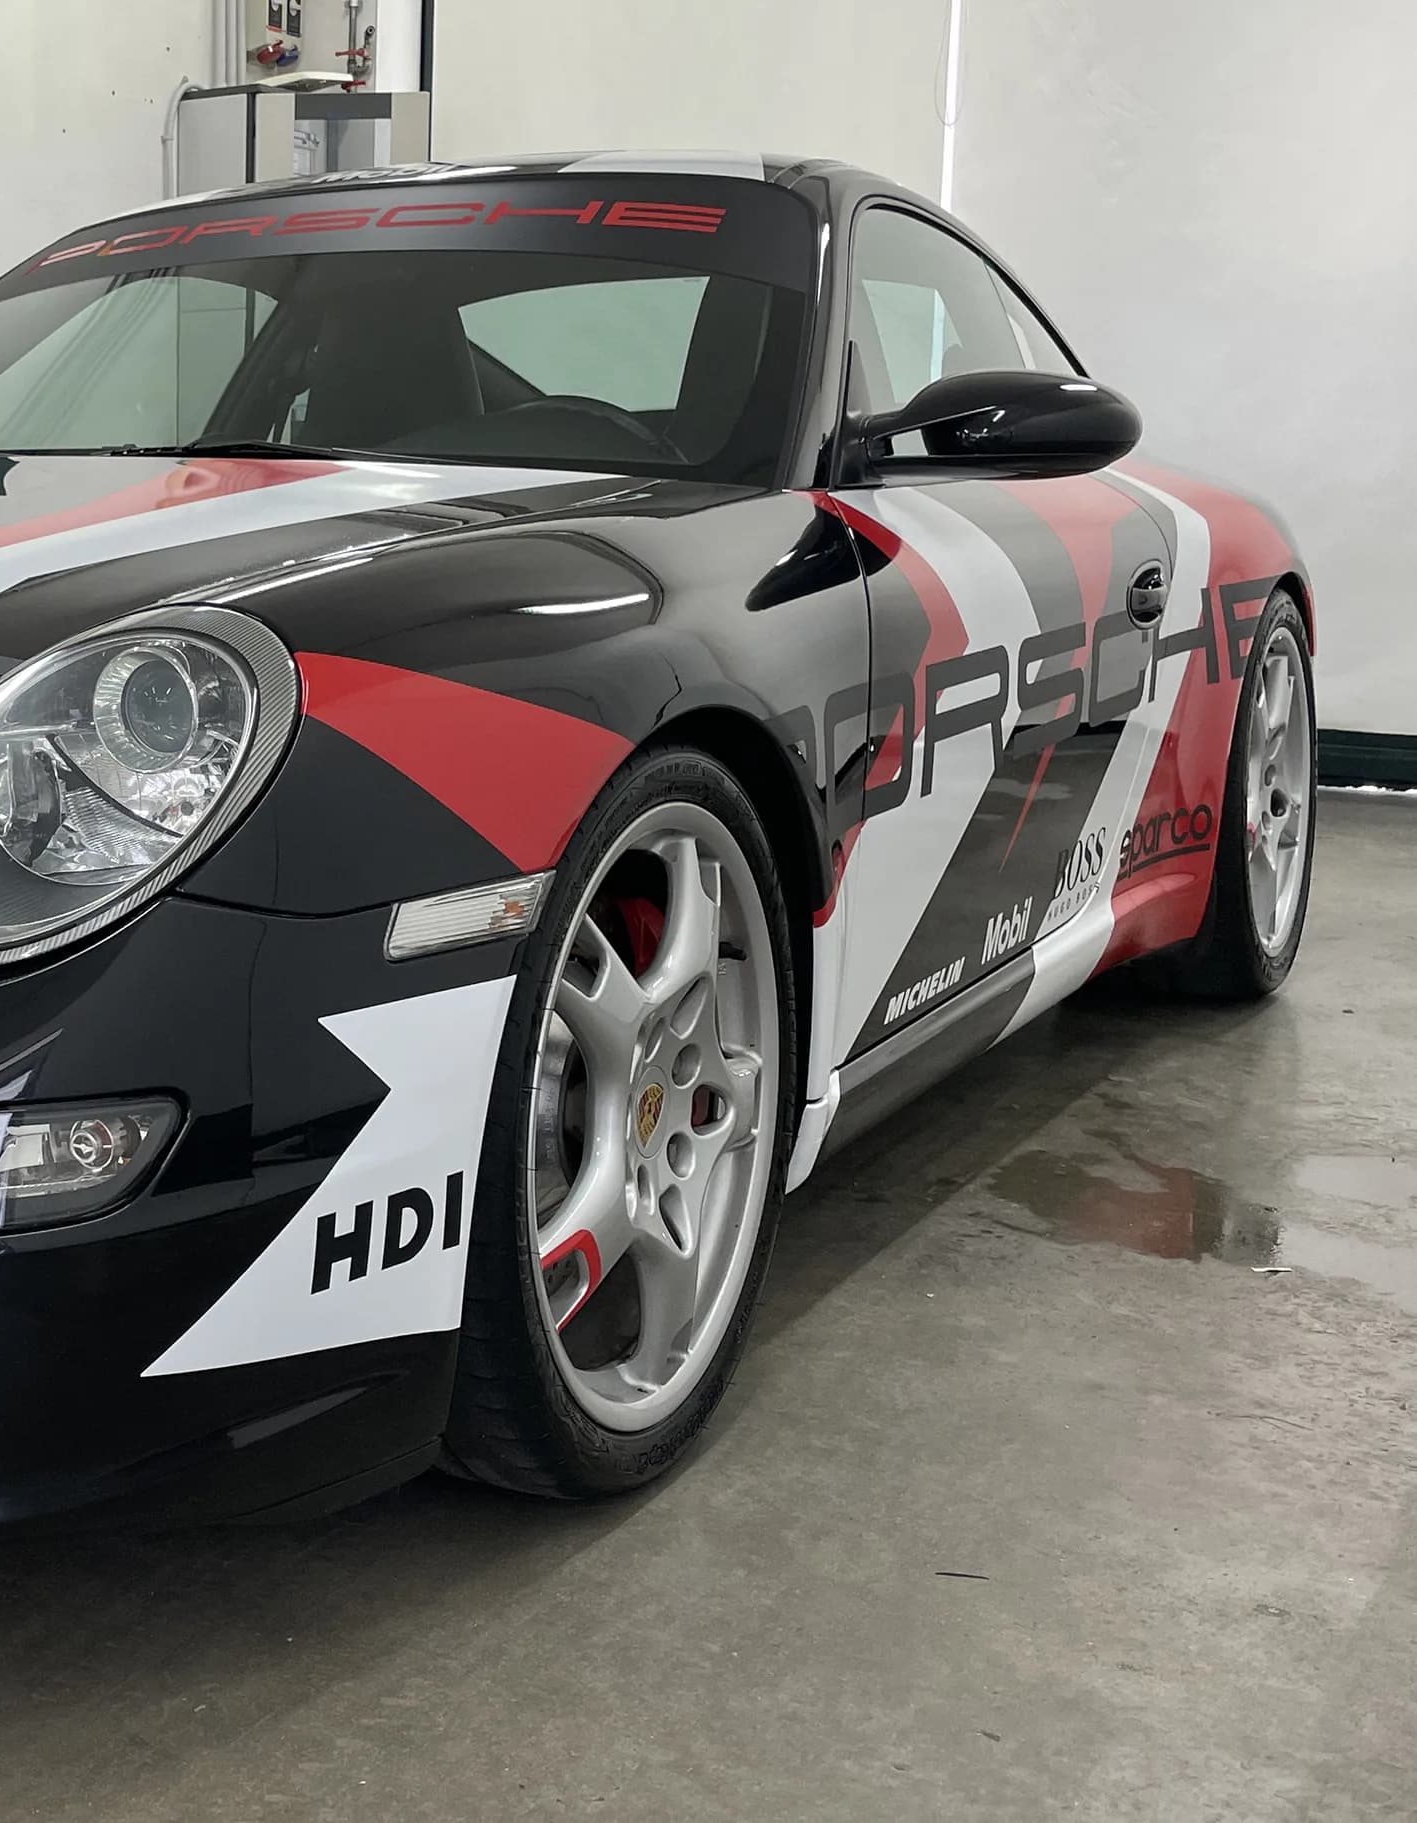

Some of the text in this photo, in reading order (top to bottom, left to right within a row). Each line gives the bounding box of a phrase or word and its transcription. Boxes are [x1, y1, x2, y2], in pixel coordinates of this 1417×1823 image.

[25, 200, 727, 277] PORSCHE
[1053, 827, 1107, 899] BOSS
[1119, 804, 1213, 882] sparco
[982, 896, 1033, 965] Mobil
[884, 956, 966, 1025] MICHELIN
[310, 1170, 465, 1295] HDI
